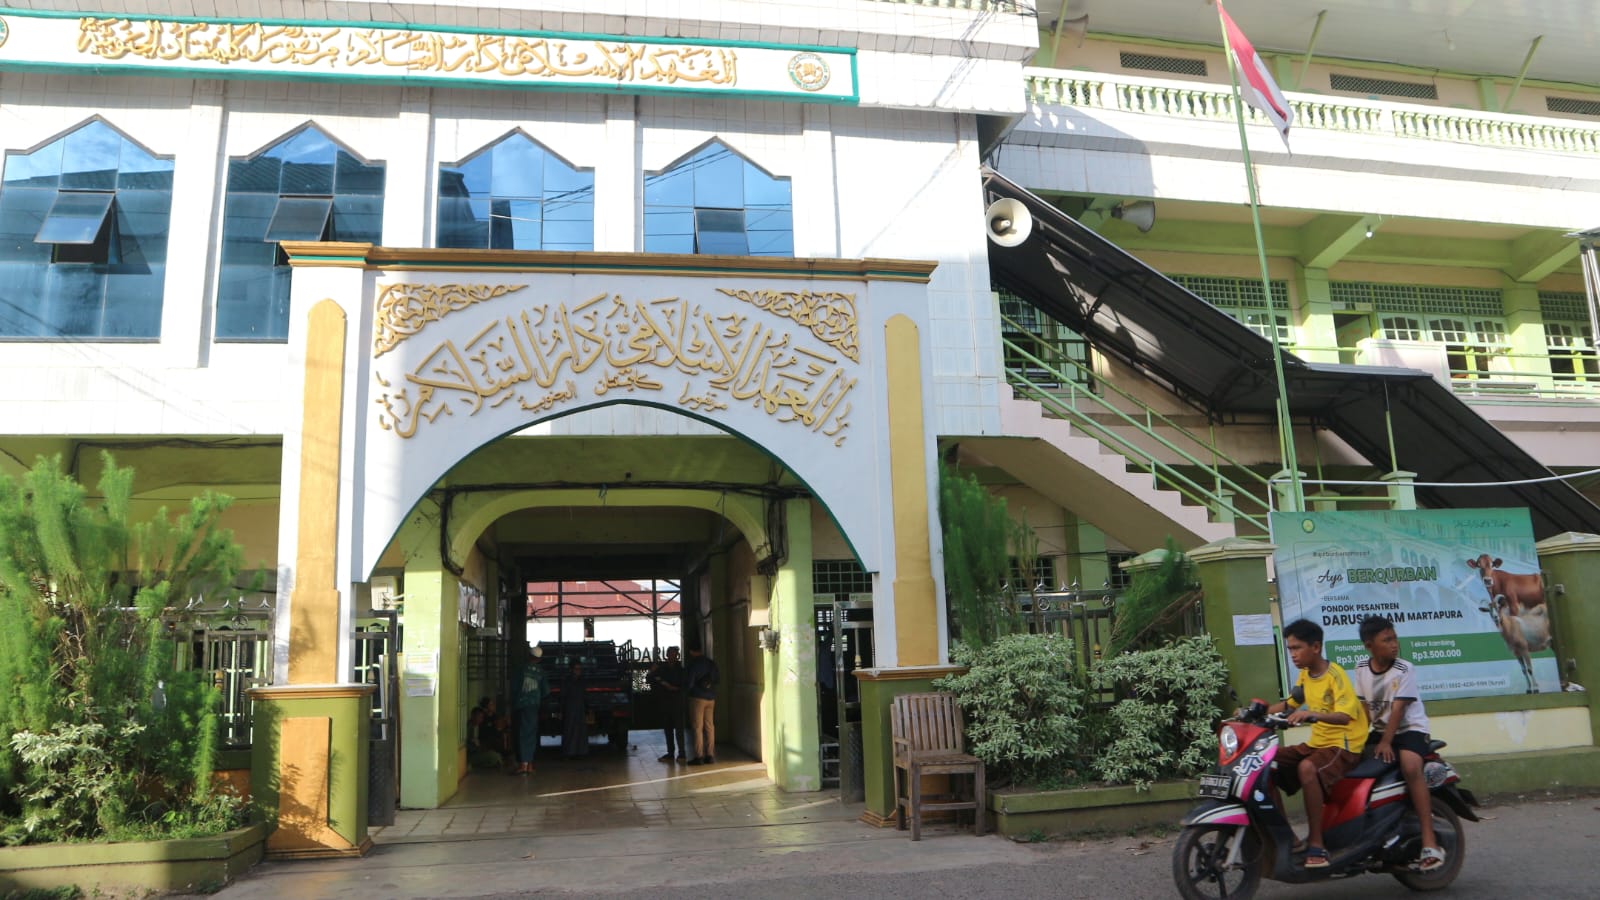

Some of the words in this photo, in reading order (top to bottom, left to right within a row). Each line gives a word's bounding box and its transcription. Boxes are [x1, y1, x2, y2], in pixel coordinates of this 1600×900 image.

[1316, 569, 1344, 588] Ayo
[1346, 566, 1438, 585] BERQURBAN
[1321, 604, 1354, 613] PONDOK
[1356, 602, 1400, 612] PESANTREN
[1407, 609, 1464, 622] MARTAPURA
[1412, 648, 1462, 662] Rp3.500.000
